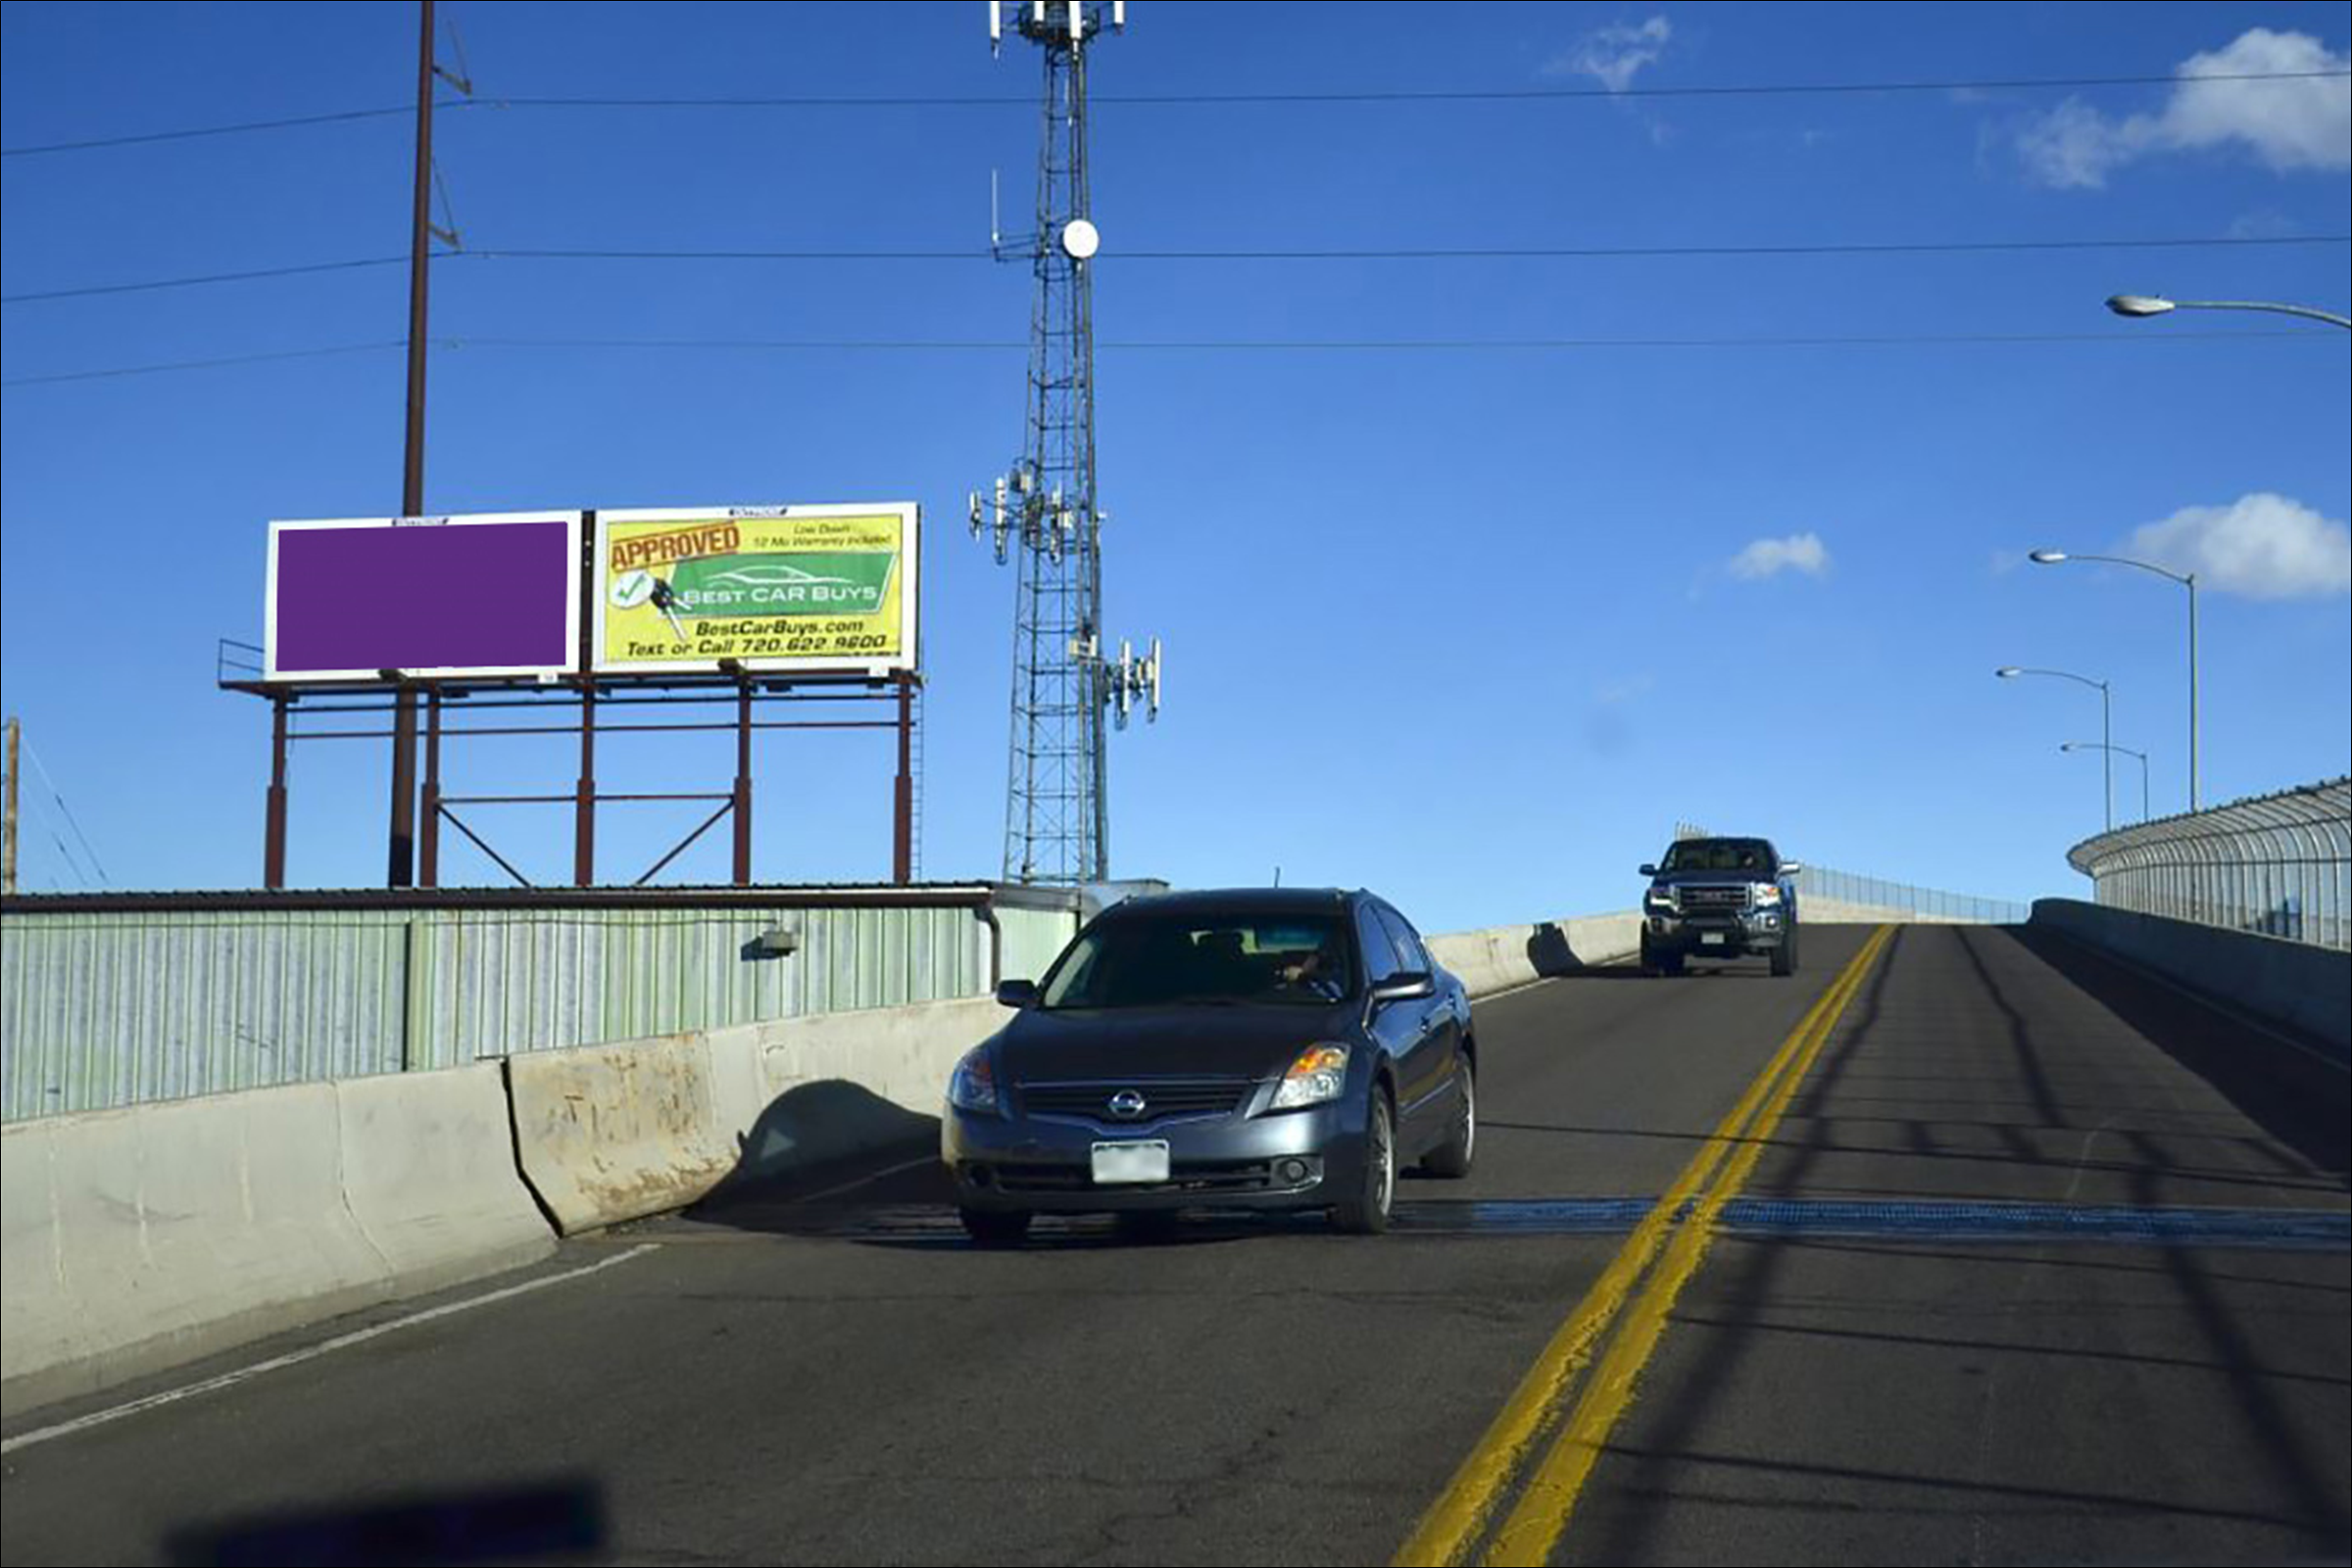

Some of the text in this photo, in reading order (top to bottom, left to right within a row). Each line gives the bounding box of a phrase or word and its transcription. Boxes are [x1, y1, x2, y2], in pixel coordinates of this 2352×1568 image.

[611, 525, 740, 568] APPROVED
[683, 585, 877, 604] BEST CAR BUYS
[696, 619, 864, 636] BestCarBuys.com
[627, 641, 665, 656] Text
[670, 644, 693, 655] or
[698, 639, 734, 654] Call
